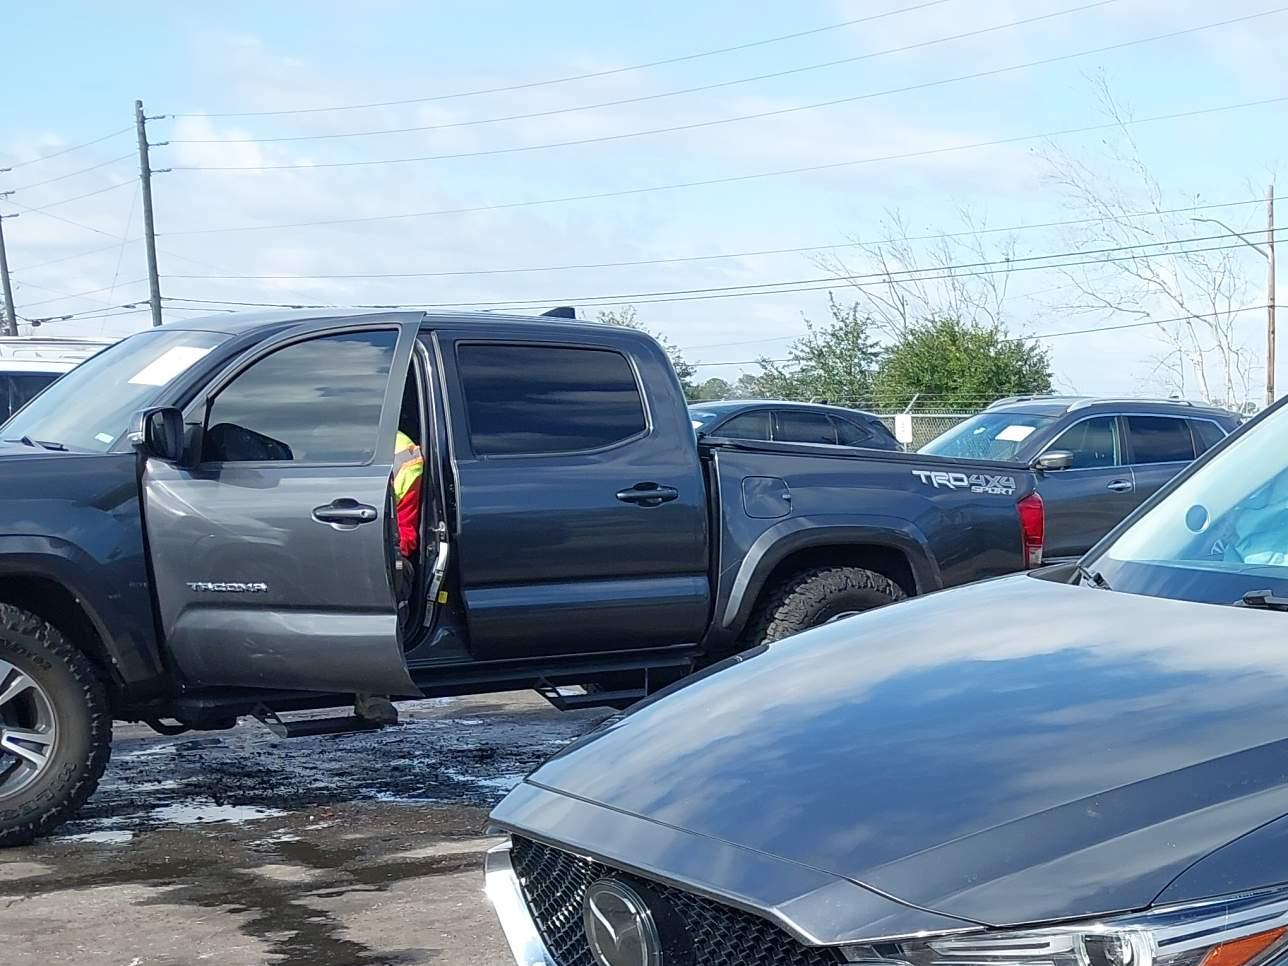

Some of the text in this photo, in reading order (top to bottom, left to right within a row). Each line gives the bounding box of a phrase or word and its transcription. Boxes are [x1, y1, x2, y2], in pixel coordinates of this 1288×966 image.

[911, 470, 969, 490] TRD
[971, 485, 1015, 495] SPORT
[185, 582, 268, 593] TACOMA
